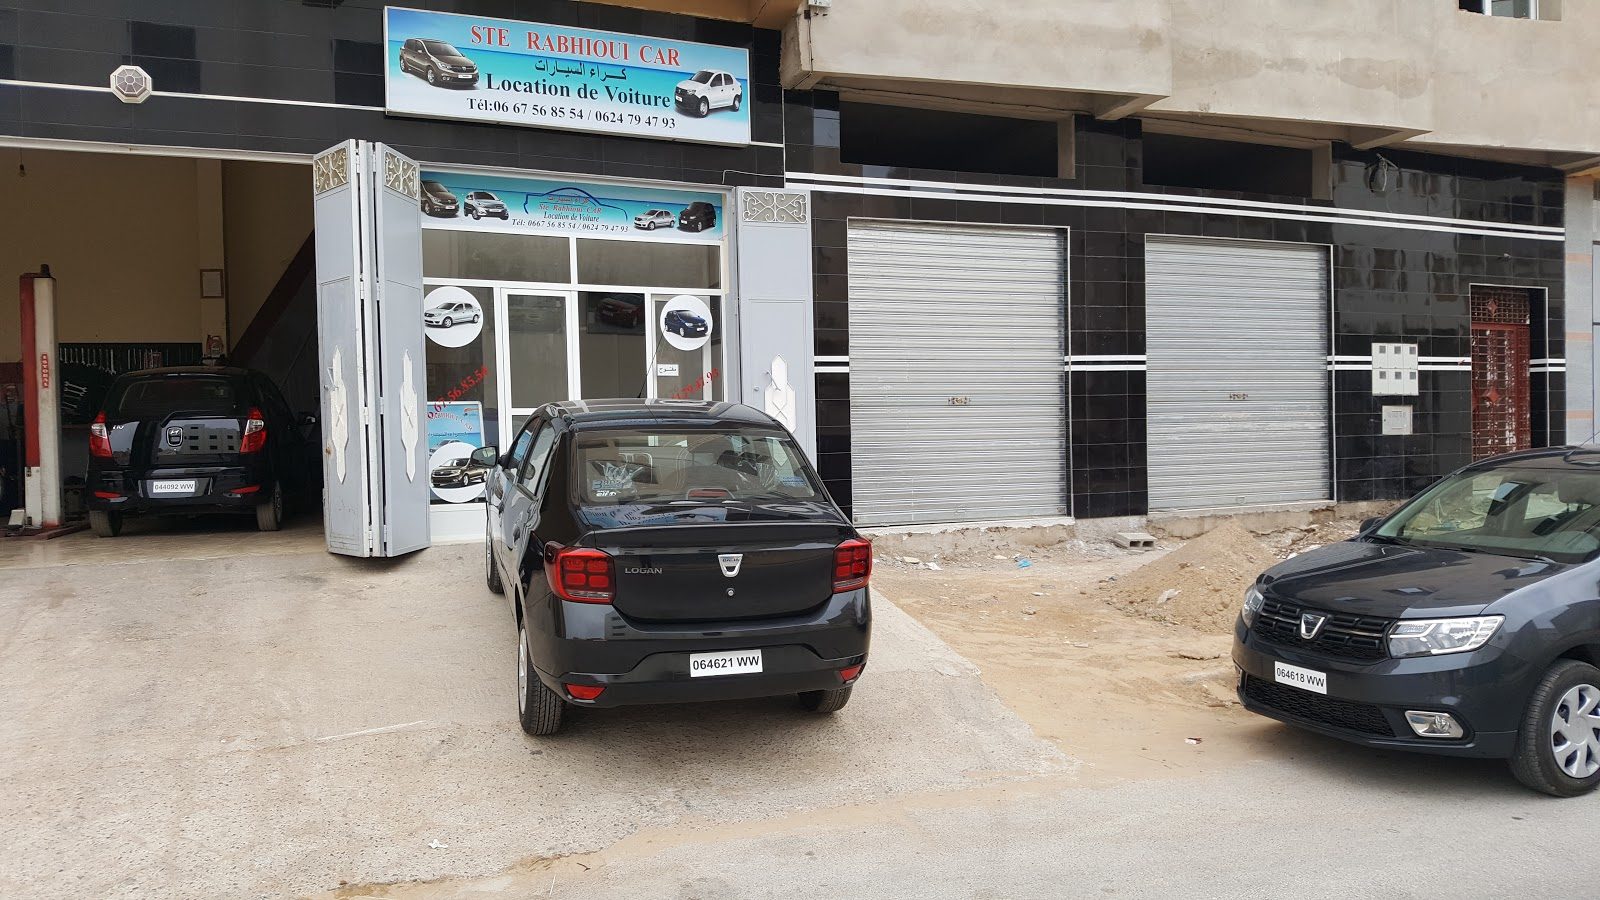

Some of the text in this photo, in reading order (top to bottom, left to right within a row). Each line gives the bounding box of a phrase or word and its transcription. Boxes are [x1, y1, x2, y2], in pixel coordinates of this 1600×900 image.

[471, 25, 681, 67] STE RABHIOUI CAR
[534, 58, 586, 78] السيارات
[485, 72, 671, 108] Location de Voiture
[513, 103, 528, 114] 67
[532, 104, 547, 116] 56
[551, 106, 566, 118] 85
[569, 108, 584, 120] 54
[595, 110, 623, 124] 0624
[627, 114, 641, 125] 79
[645, 116, 658, 127] 47
[662, 118, 676, 129] 93
[544, 211, 600, 223] Location de Voiture
[692, 656, 760, 670] 064621 WW
[1276, 668, 1325, 687] 064618 WW
